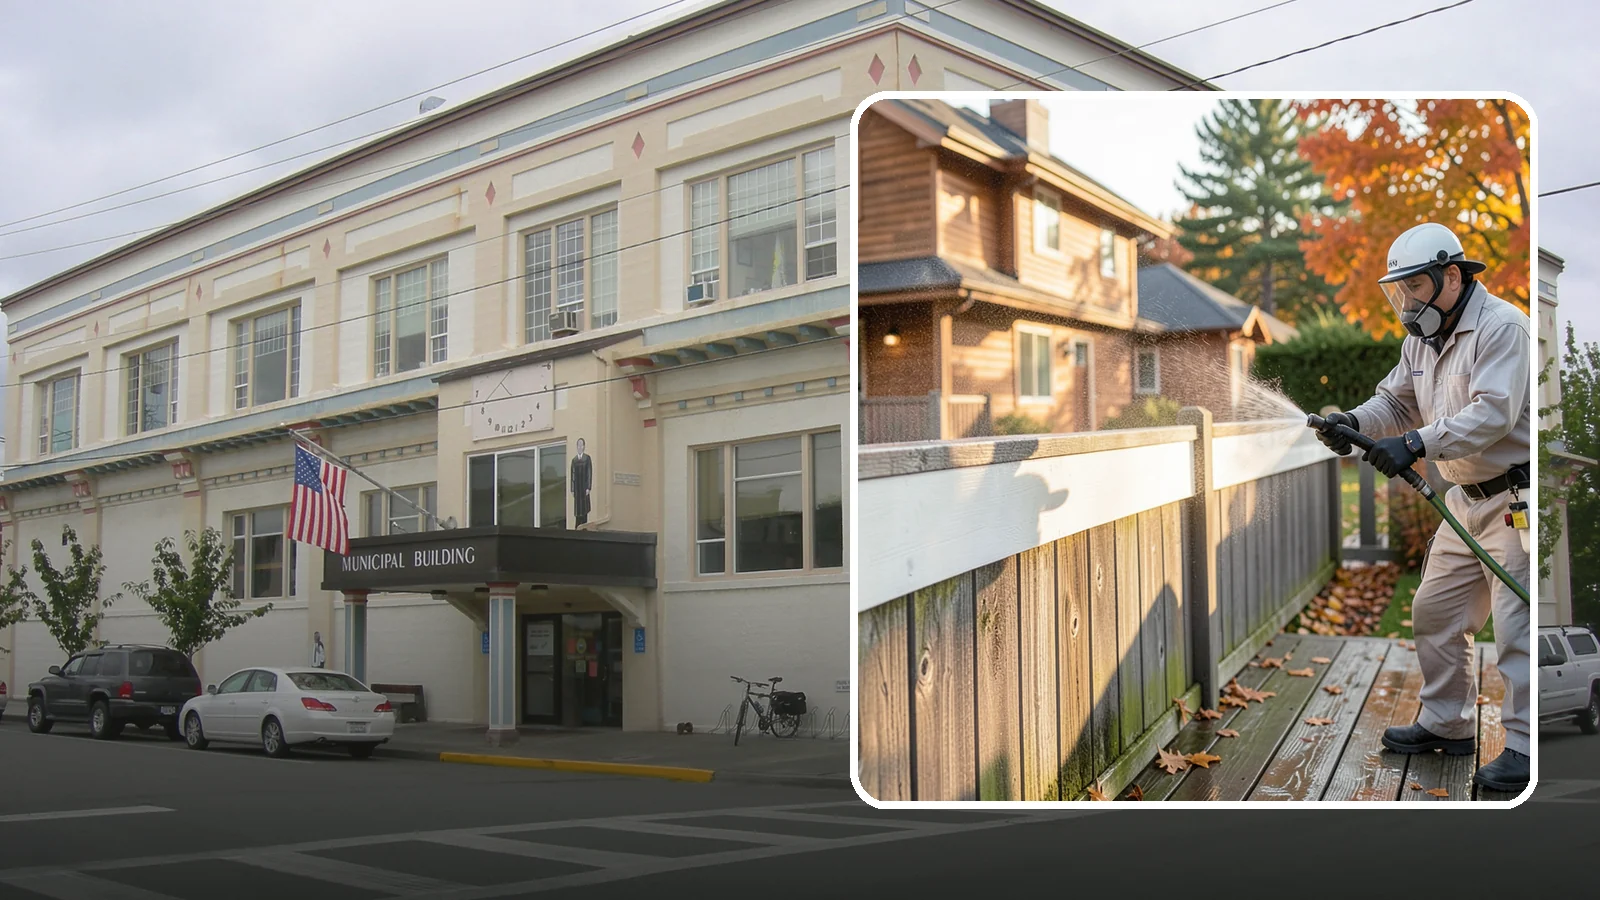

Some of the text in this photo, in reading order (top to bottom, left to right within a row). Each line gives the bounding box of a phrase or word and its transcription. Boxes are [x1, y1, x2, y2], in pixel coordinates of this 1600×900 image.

[480, 407, 484, 415] 8
[488, 418, 492, 426] 9
[494, 424, 500, 432] 10
[529, 414, 532, 422] 3
[536, 402, 540, 410] 4
[342, 546, 475, 572] MUNICIPAL BUILDING
